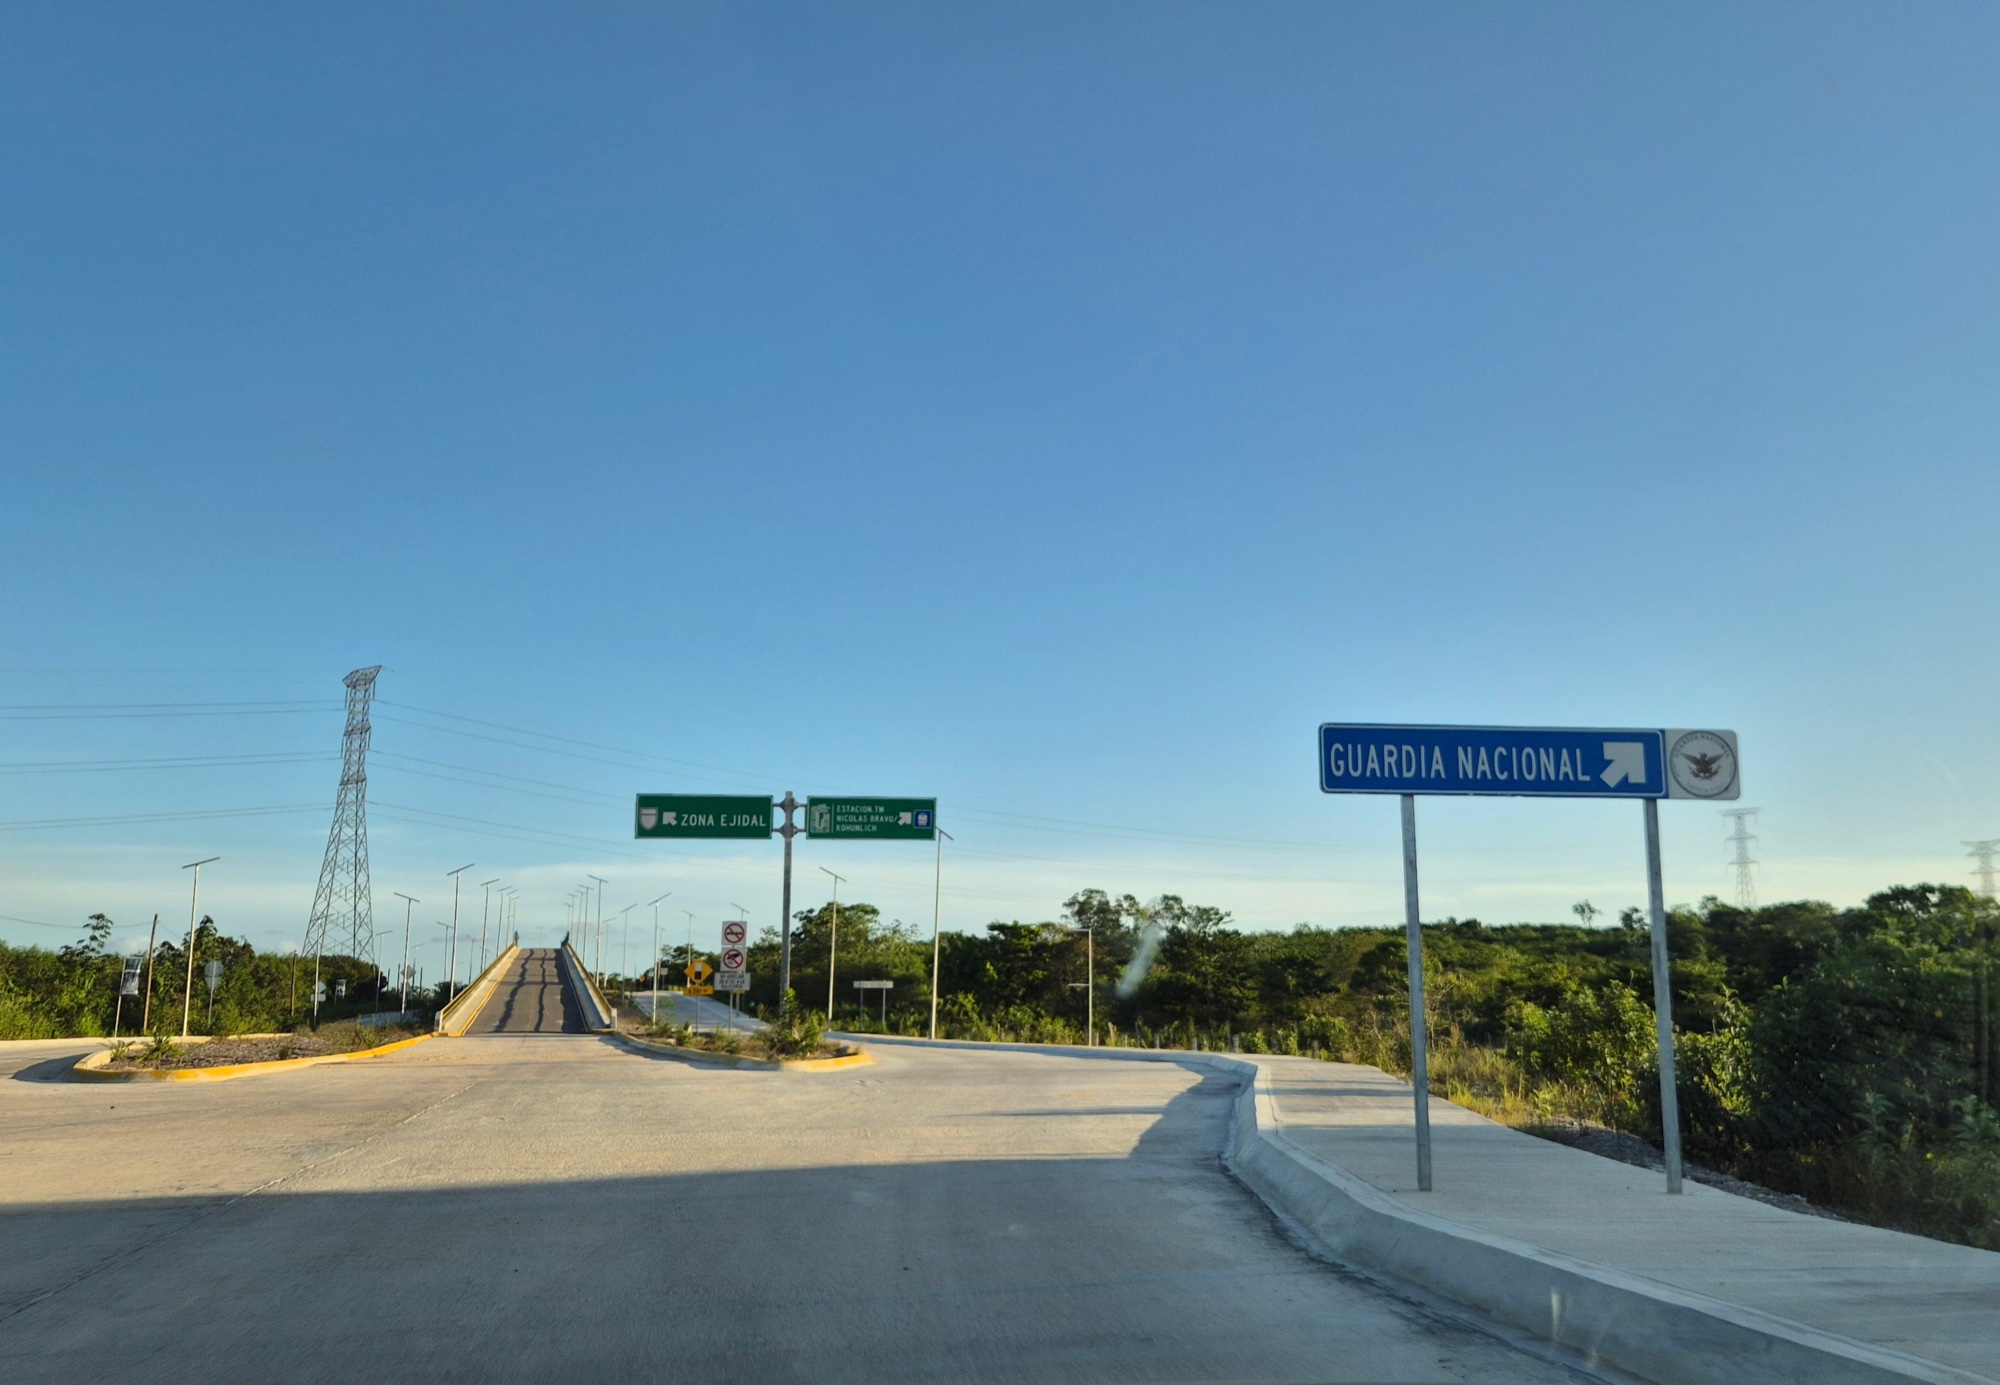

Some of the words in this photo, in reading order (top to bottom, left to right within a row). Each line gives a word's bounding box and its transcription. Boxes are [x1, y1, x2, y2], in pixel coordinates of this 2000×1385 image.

[1330, 743, 1446, 779] GUARDIA
[1457, 746, 1591, 781] NACIONAL
[680, 813, 715, 827] ZONA
[720, 813, 766, 827] EJIDAL
[836, 814, 867, 822] NICOLAS
[836, 824, 877, 832] KOHUNLICH
